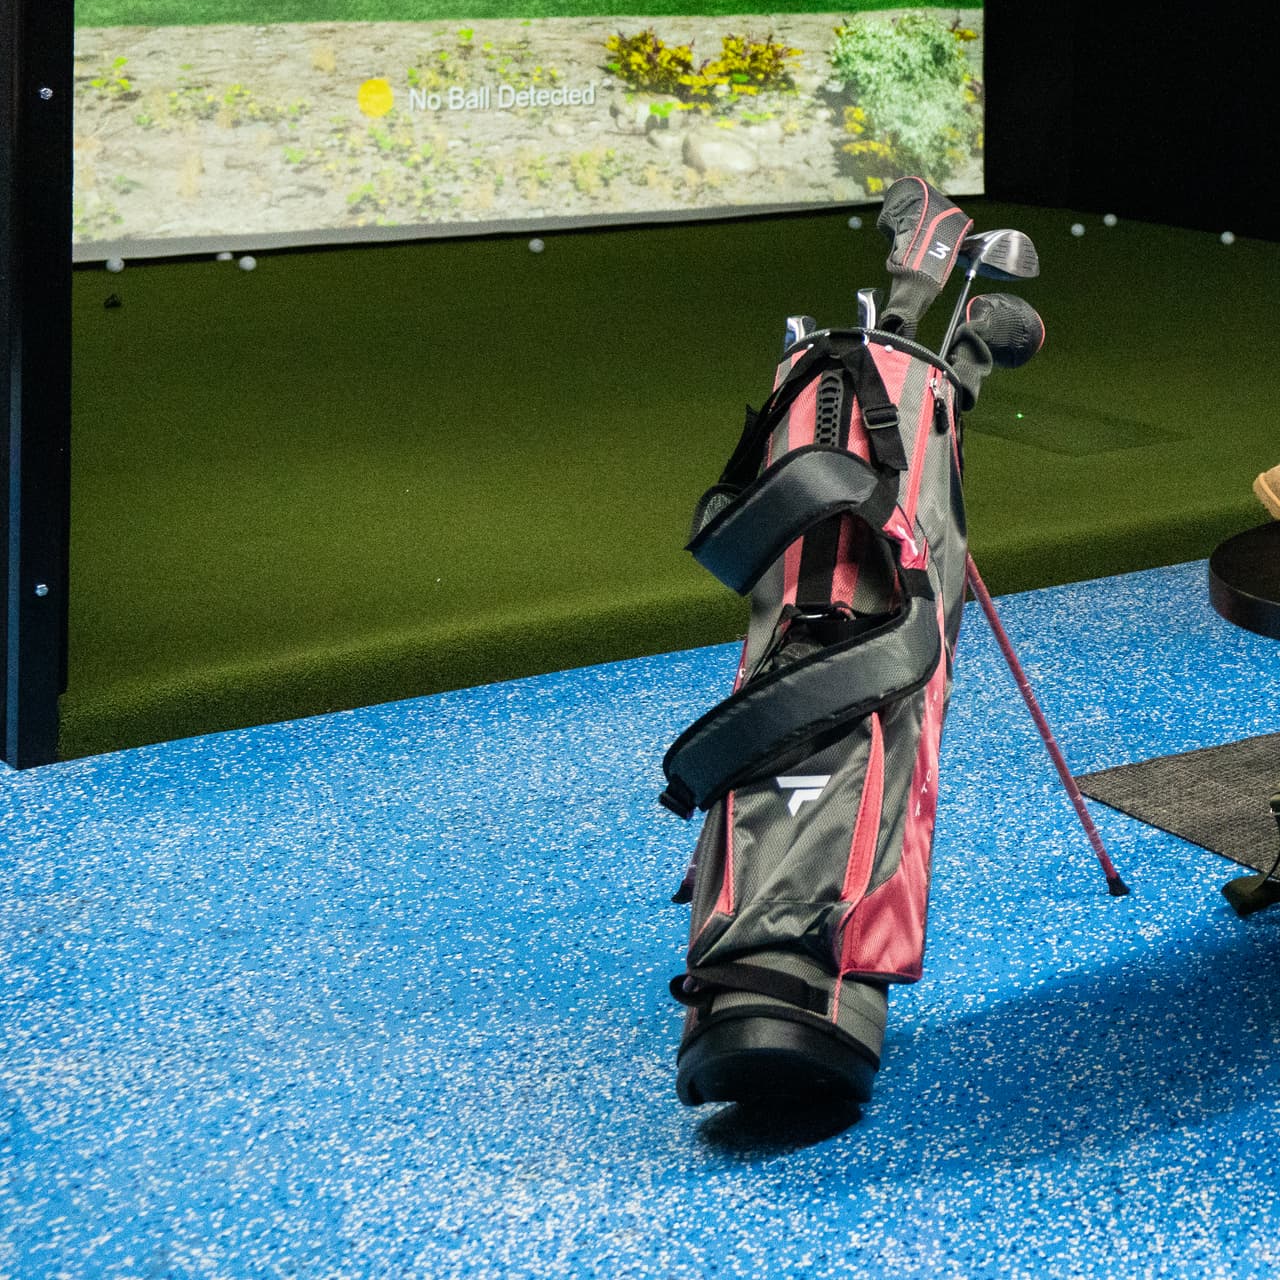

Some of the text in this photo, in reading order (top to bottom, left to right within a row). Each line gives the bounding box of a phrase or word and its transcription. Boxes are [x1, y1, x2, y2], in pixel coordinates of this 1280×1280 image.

[408, 83, 598, 112] No Ball Detected
